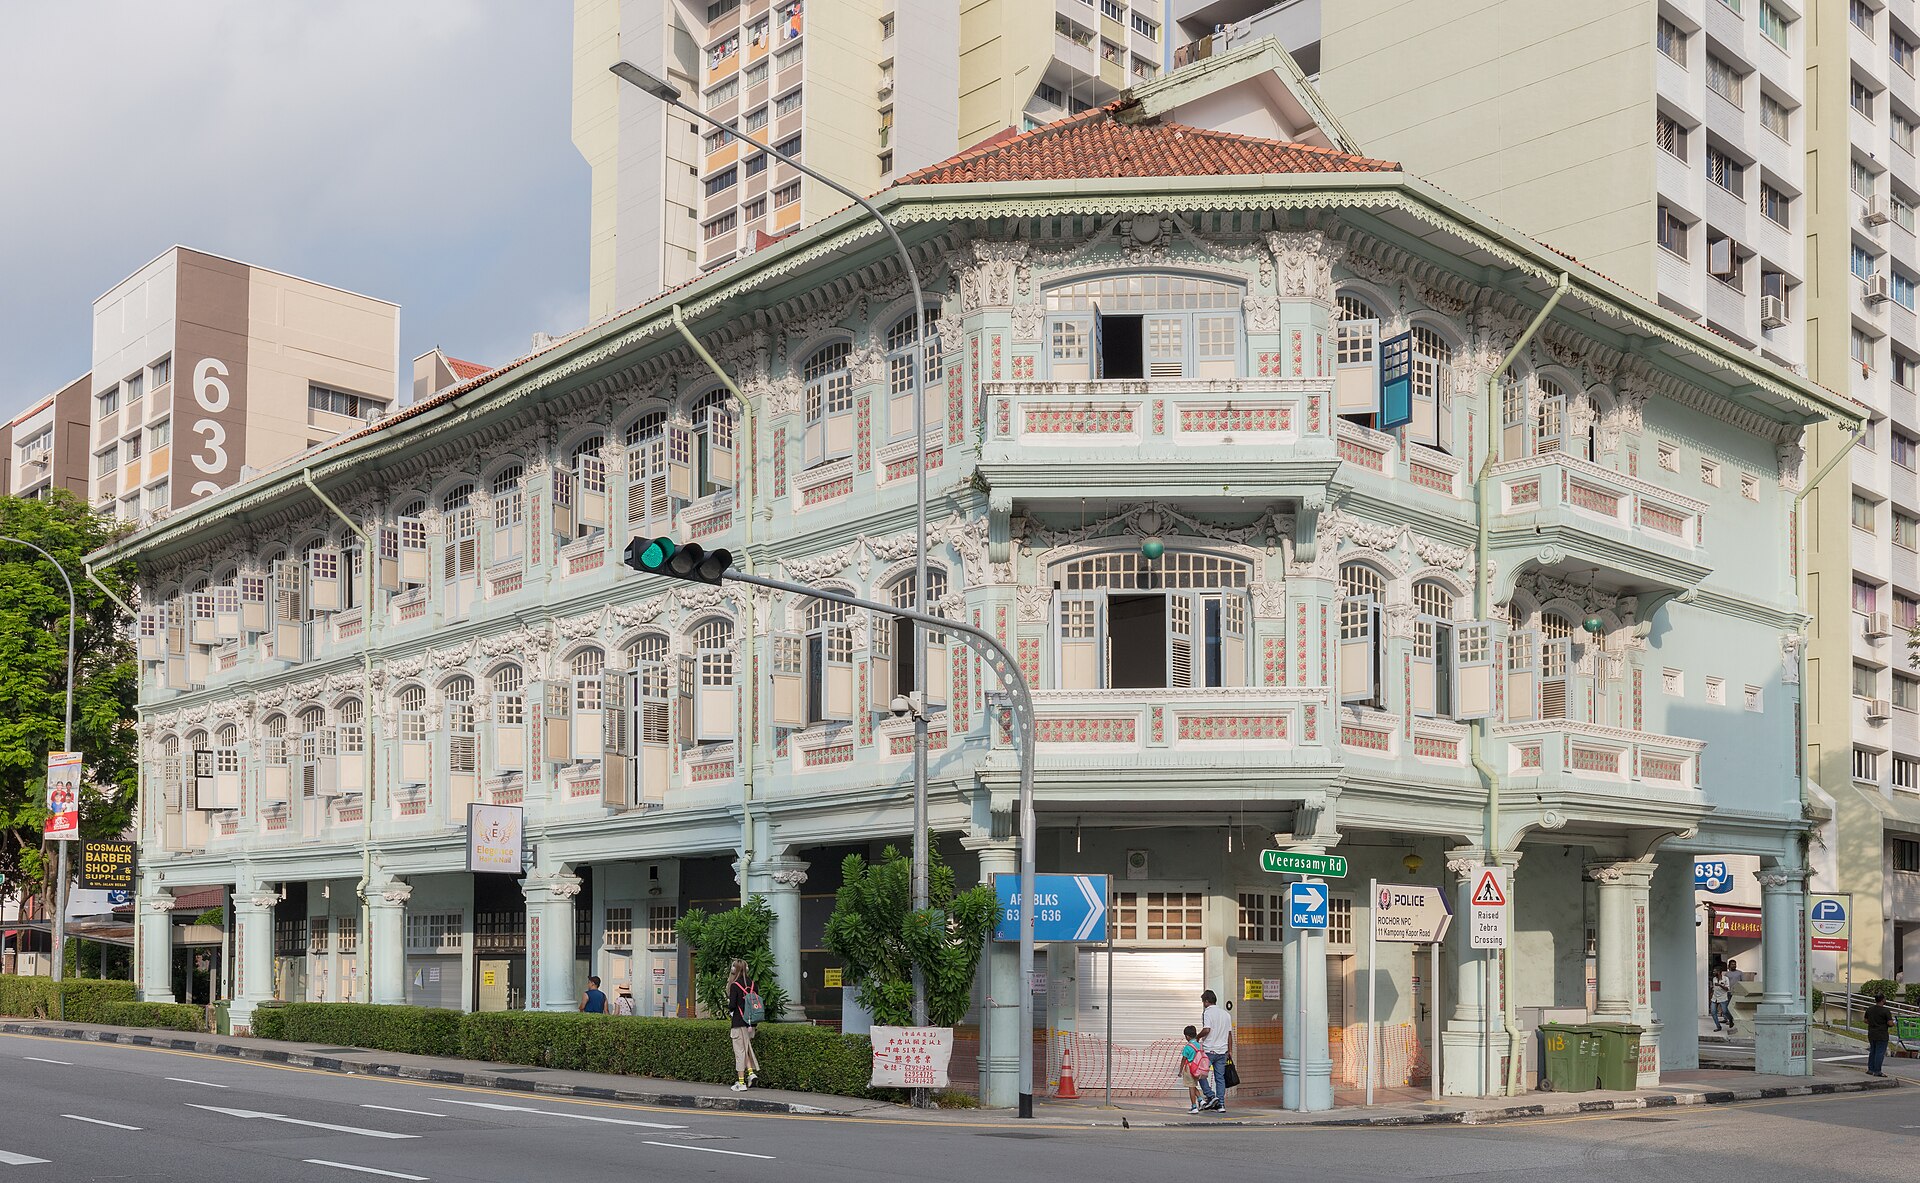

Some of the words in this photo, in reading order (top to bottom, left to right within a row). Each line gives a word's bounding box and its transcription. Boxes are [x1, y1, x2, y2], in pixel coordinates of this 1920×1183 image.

[86, 842, 132, 853] GOSMACK
[85, 852, 132, 864] BARBER
[1268, 853, 1327, 873] Veerasamy
[1329, 858, 1342, 872] Rd
[85, 863, 118, 874] SHOP
[1695, 863, 1723, 877] 635
[85, 873, 132, 882] SUPPLIES
[1034, 893, 1059, 906] BLKS
[1394, 894, 1425, 907] POLICE
[1041, 909, 1061, 922] 636
[1477, 911, 1499, 919] Raised
[1821, 902, 1838, 919] P
[1294, 914, 1309, 924] ONE
[1310, 914, 1325, 924] WAY
[1378, 916, 1401, 926] ROCHOR
[1401, 917, 1412, 926] NPC
[1479, 923, 1498, 931] Zebra
[1377, 928, 1383, 936] 11
[1383, 928, 1405, 938] Kampong
[1405, 929, 1419, 938] Kapor
[1419, 929, 1431, 937] Road
[1474, 936, 1503, 946] Crossing
